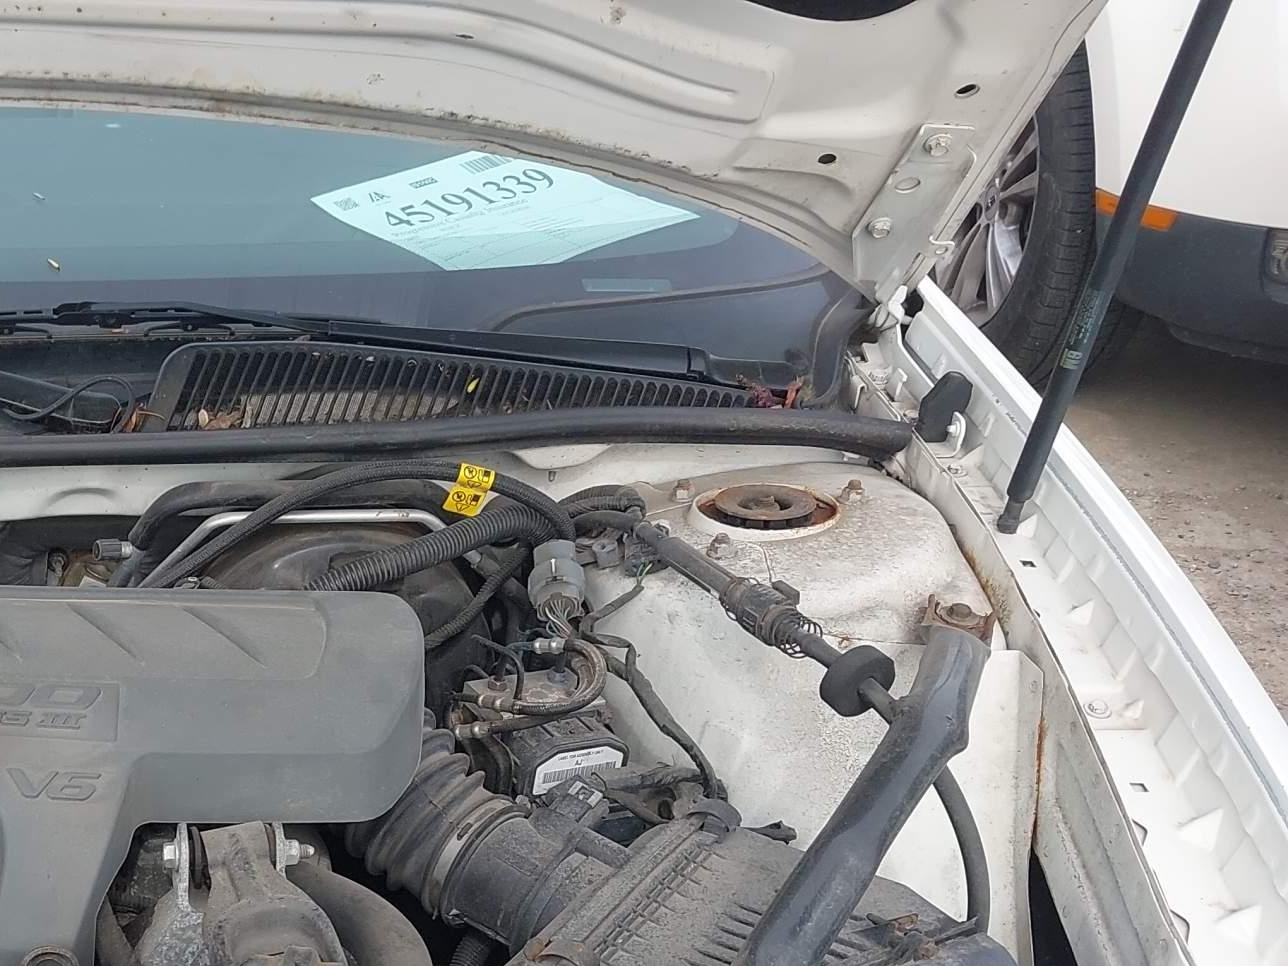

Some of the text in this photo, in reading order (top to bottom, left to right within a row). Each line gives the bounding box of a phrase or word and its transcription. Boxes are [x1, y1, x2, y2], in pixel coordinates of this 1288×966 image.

[384, 166, 554, 229] 45191339
[37, 711, 88, 730] III
[6, 767, 102, 802] V6
